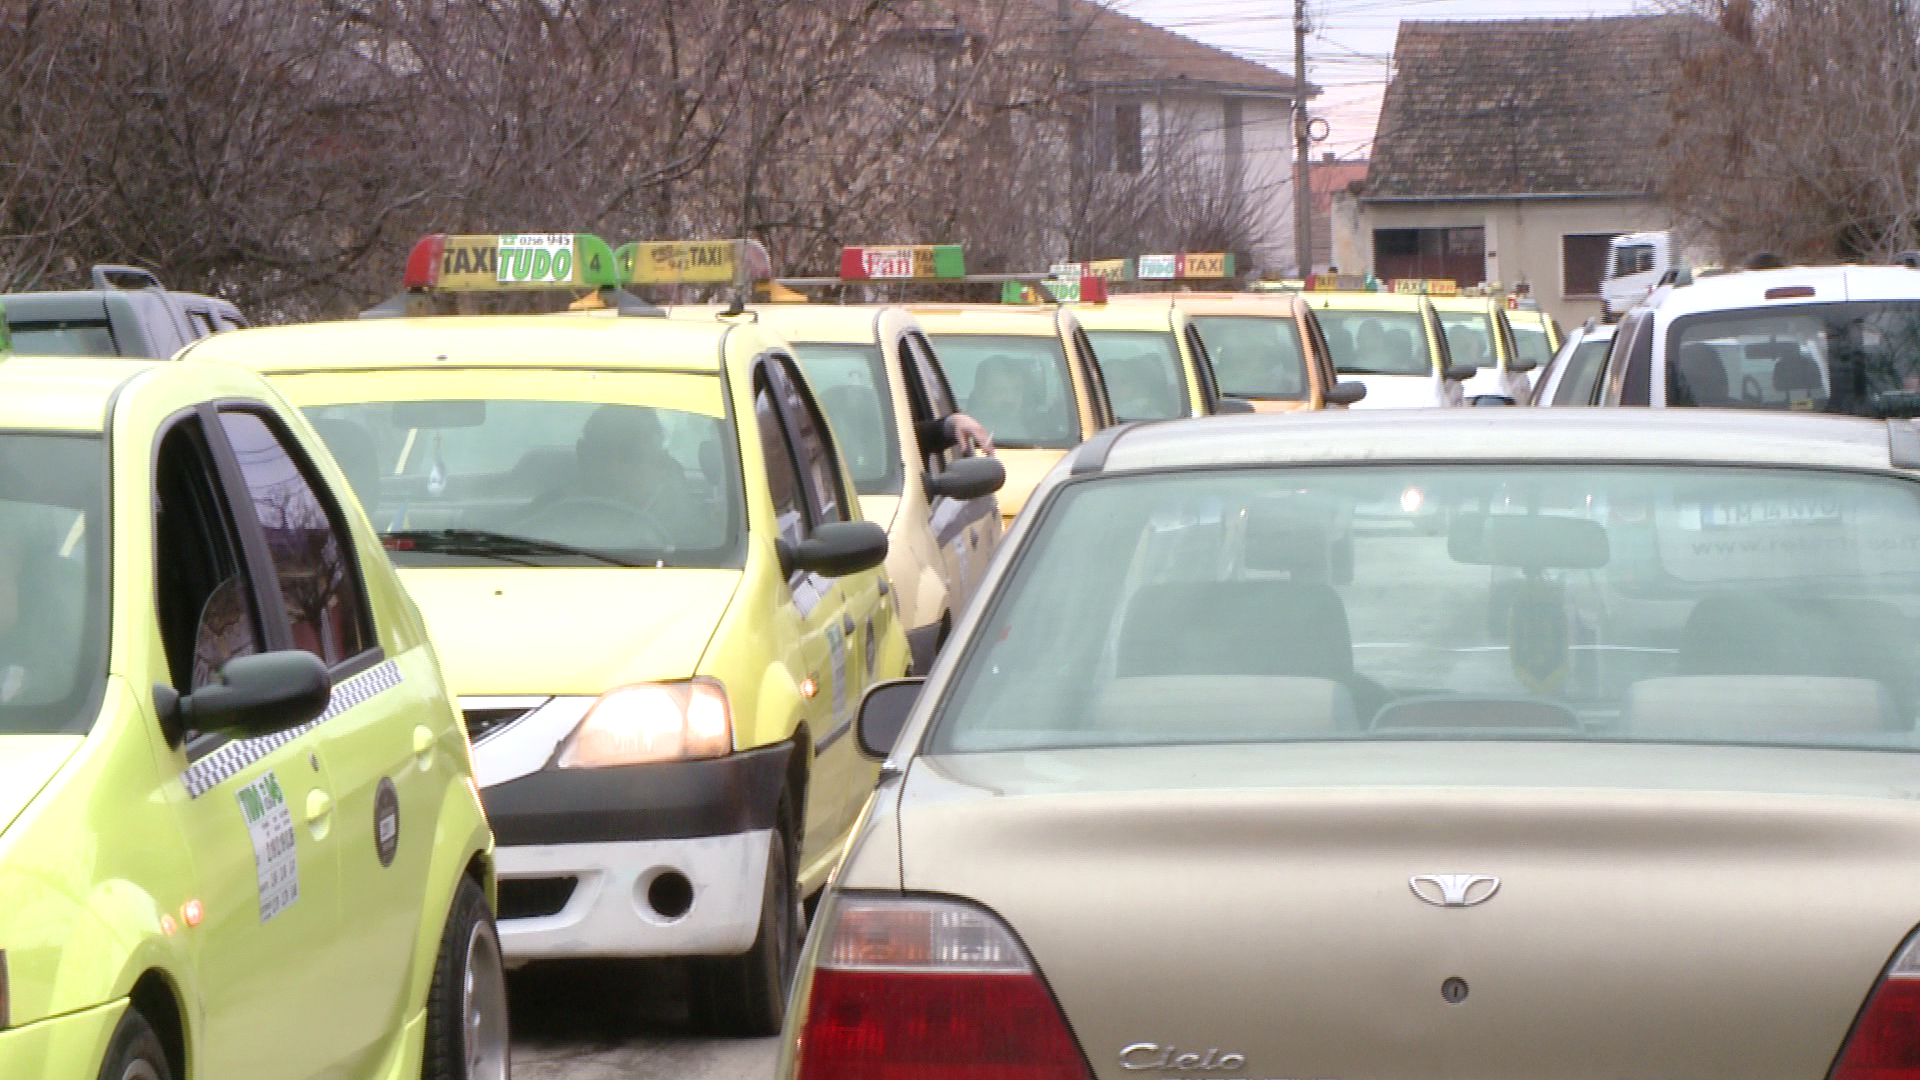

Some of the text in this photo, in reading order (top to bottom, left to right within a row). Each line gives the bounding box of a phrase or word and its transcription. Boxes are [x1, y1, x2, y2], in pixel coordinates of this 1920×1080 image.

[443, 247, 497, 274] TAXI
[498, 248, 573, 281] TUDO
[689, 247, 722, 268] TAXI
[1187, 258, 1223, 273] TAXI
[1119, 1042, 1246, 1070] Cielo
